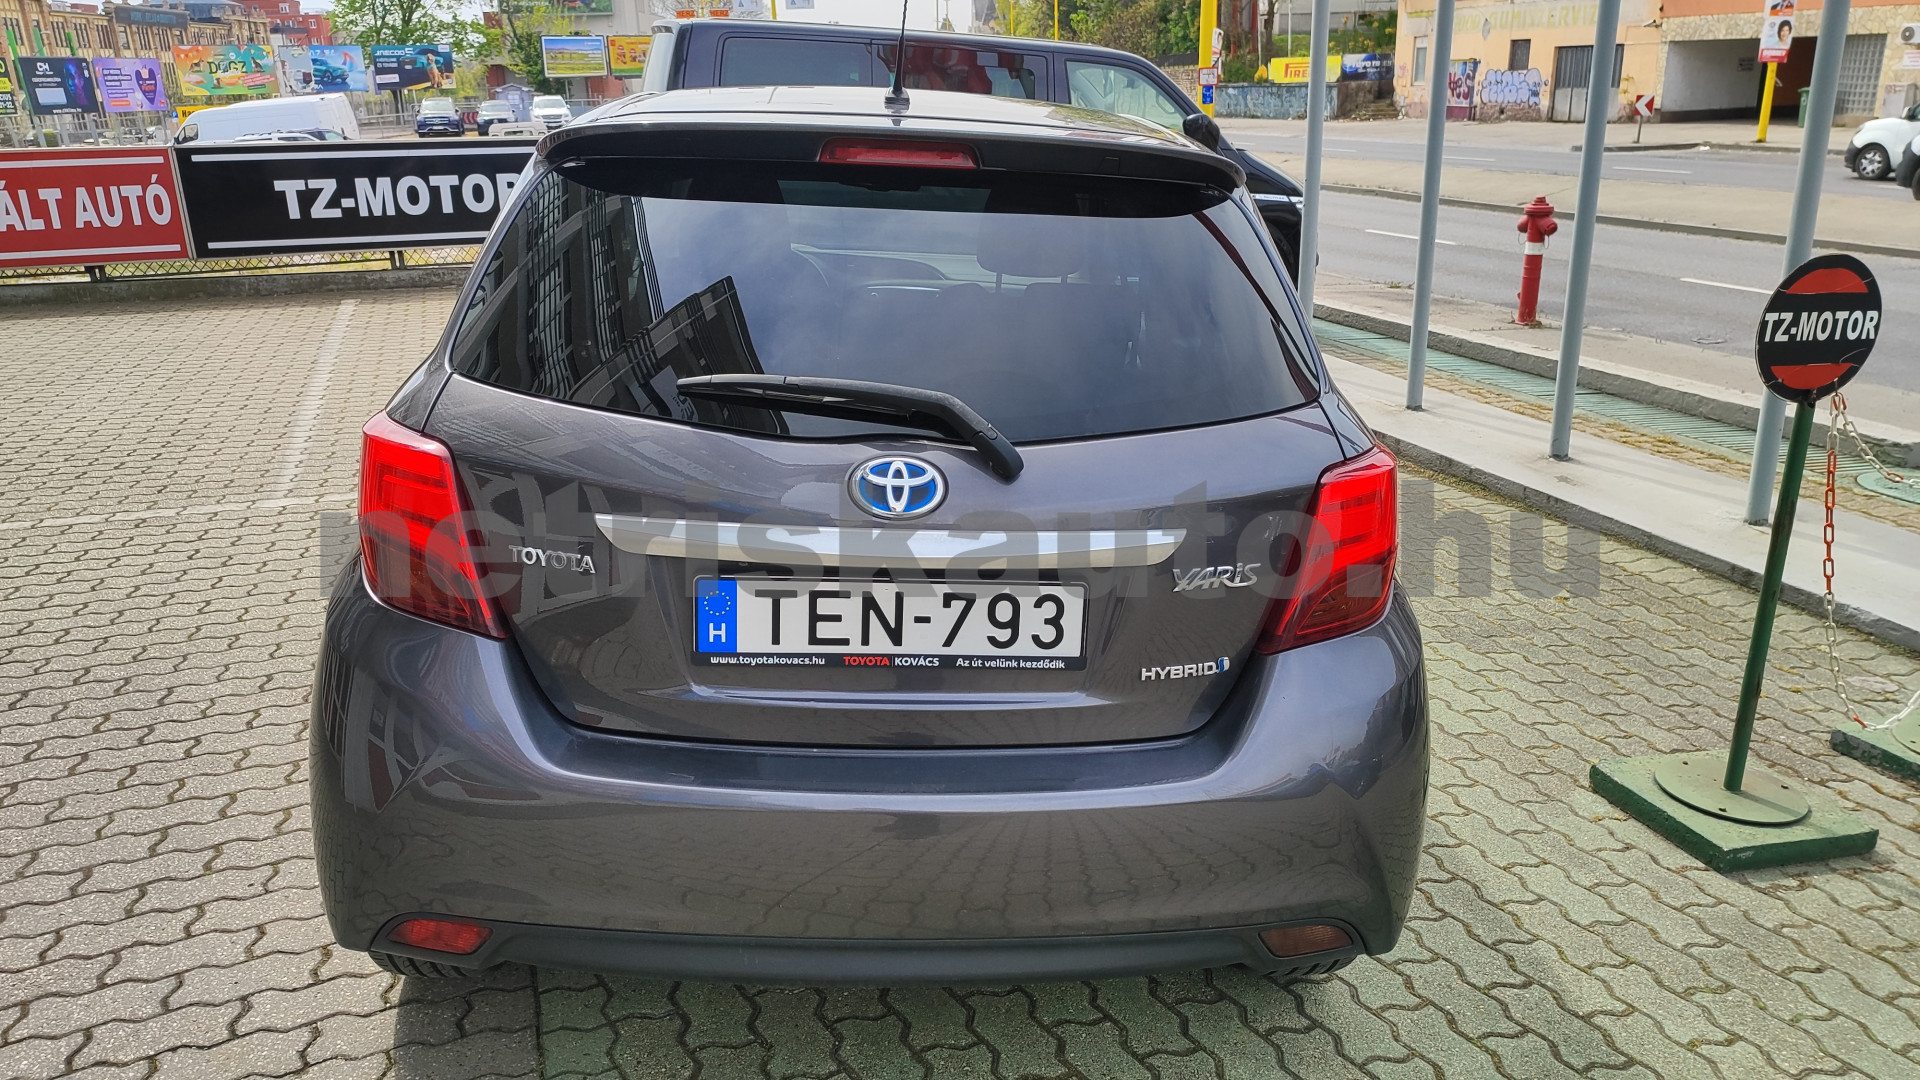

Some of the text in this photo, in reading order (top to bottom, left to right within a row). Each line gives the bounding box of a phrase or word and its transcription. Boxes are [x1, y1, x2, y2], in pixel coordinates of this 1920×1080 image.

[0, 174, 172, 232] ÁLT AUTÓ
[1764, 311, 1879, 342] TZ-MOTOR
[509, 545, 596, 573] TOYOTA
[708, 589, 1065, 650] H TEN-793
[710, 655, 826, 666] www.toyotakovacs.hu
[843, 655, 940, 667] TOYOTA KOVÁCS
[956, 657, 1066, 669] Az út velünk kezdődik
[1141, 661, 1218, 681] HYBRID
